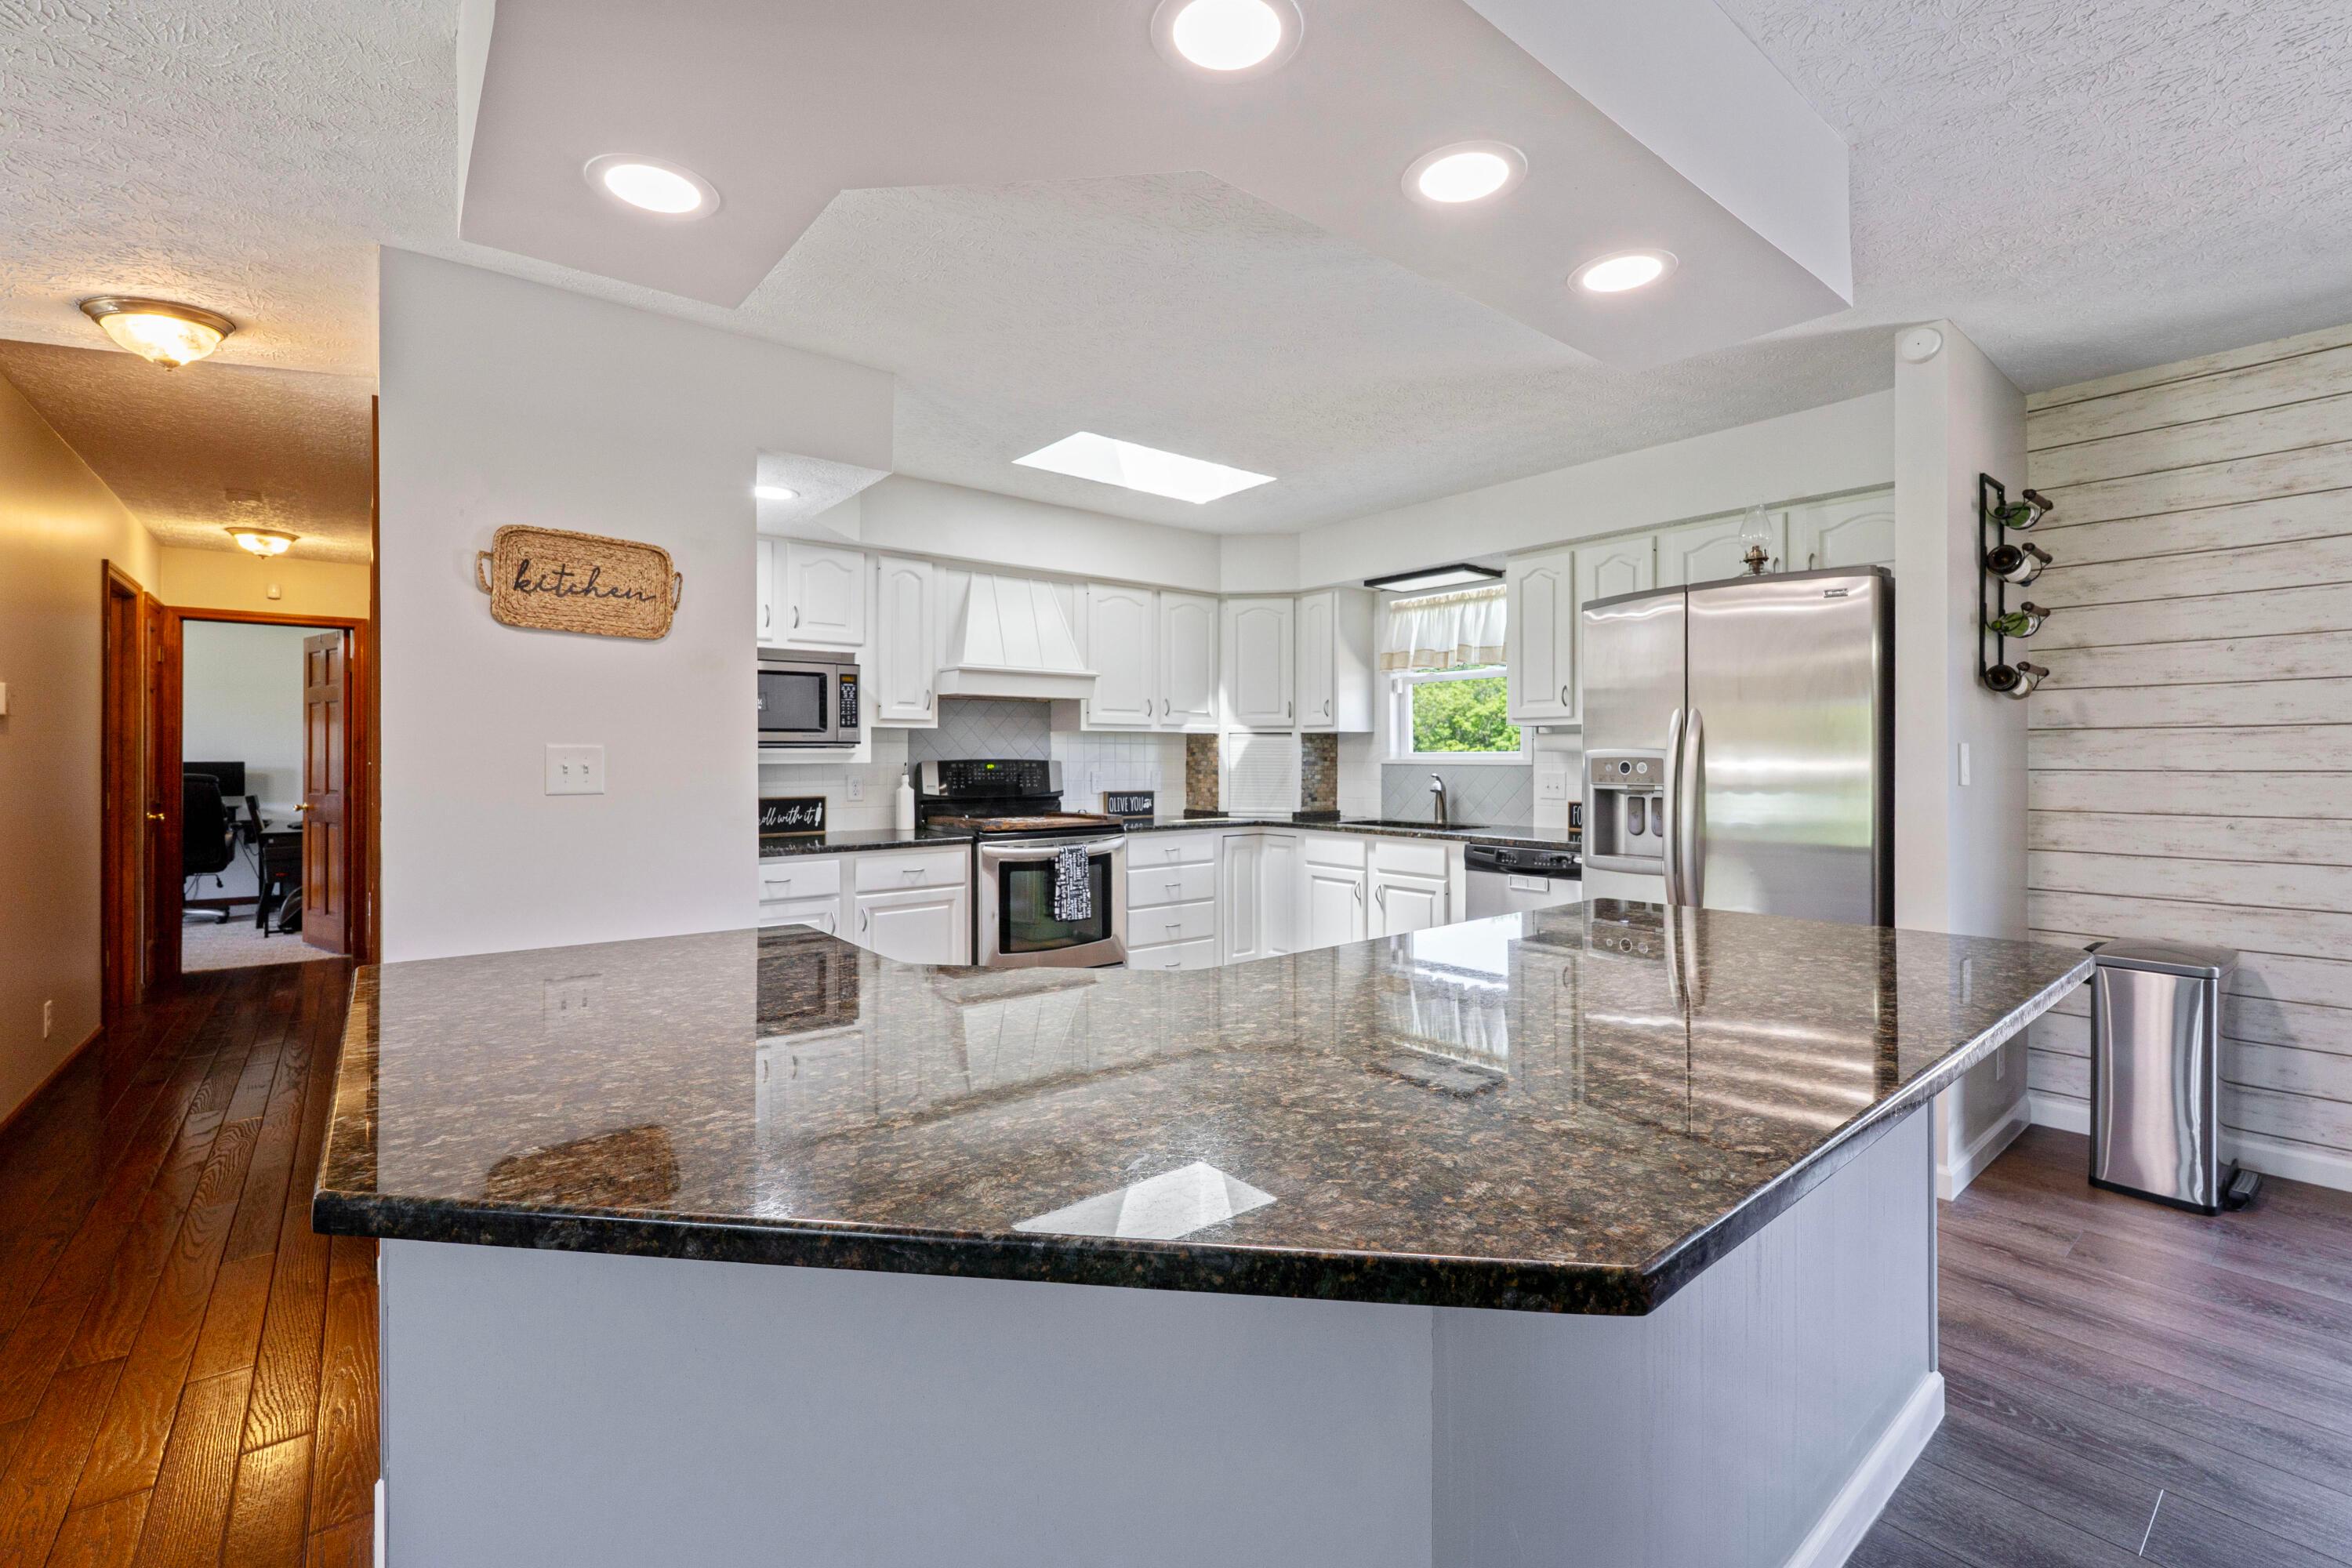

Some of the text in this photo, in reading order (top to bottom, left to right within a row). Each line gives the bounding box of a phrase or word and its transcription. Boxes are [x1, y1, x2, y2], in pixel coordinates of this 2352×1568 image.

[514, 559, 656, 601] kitchen
[1109, 796, 1144, 812] OLIVE YOU
[778, 805, 802, 825] with
[804, 806, 815, 824] it
